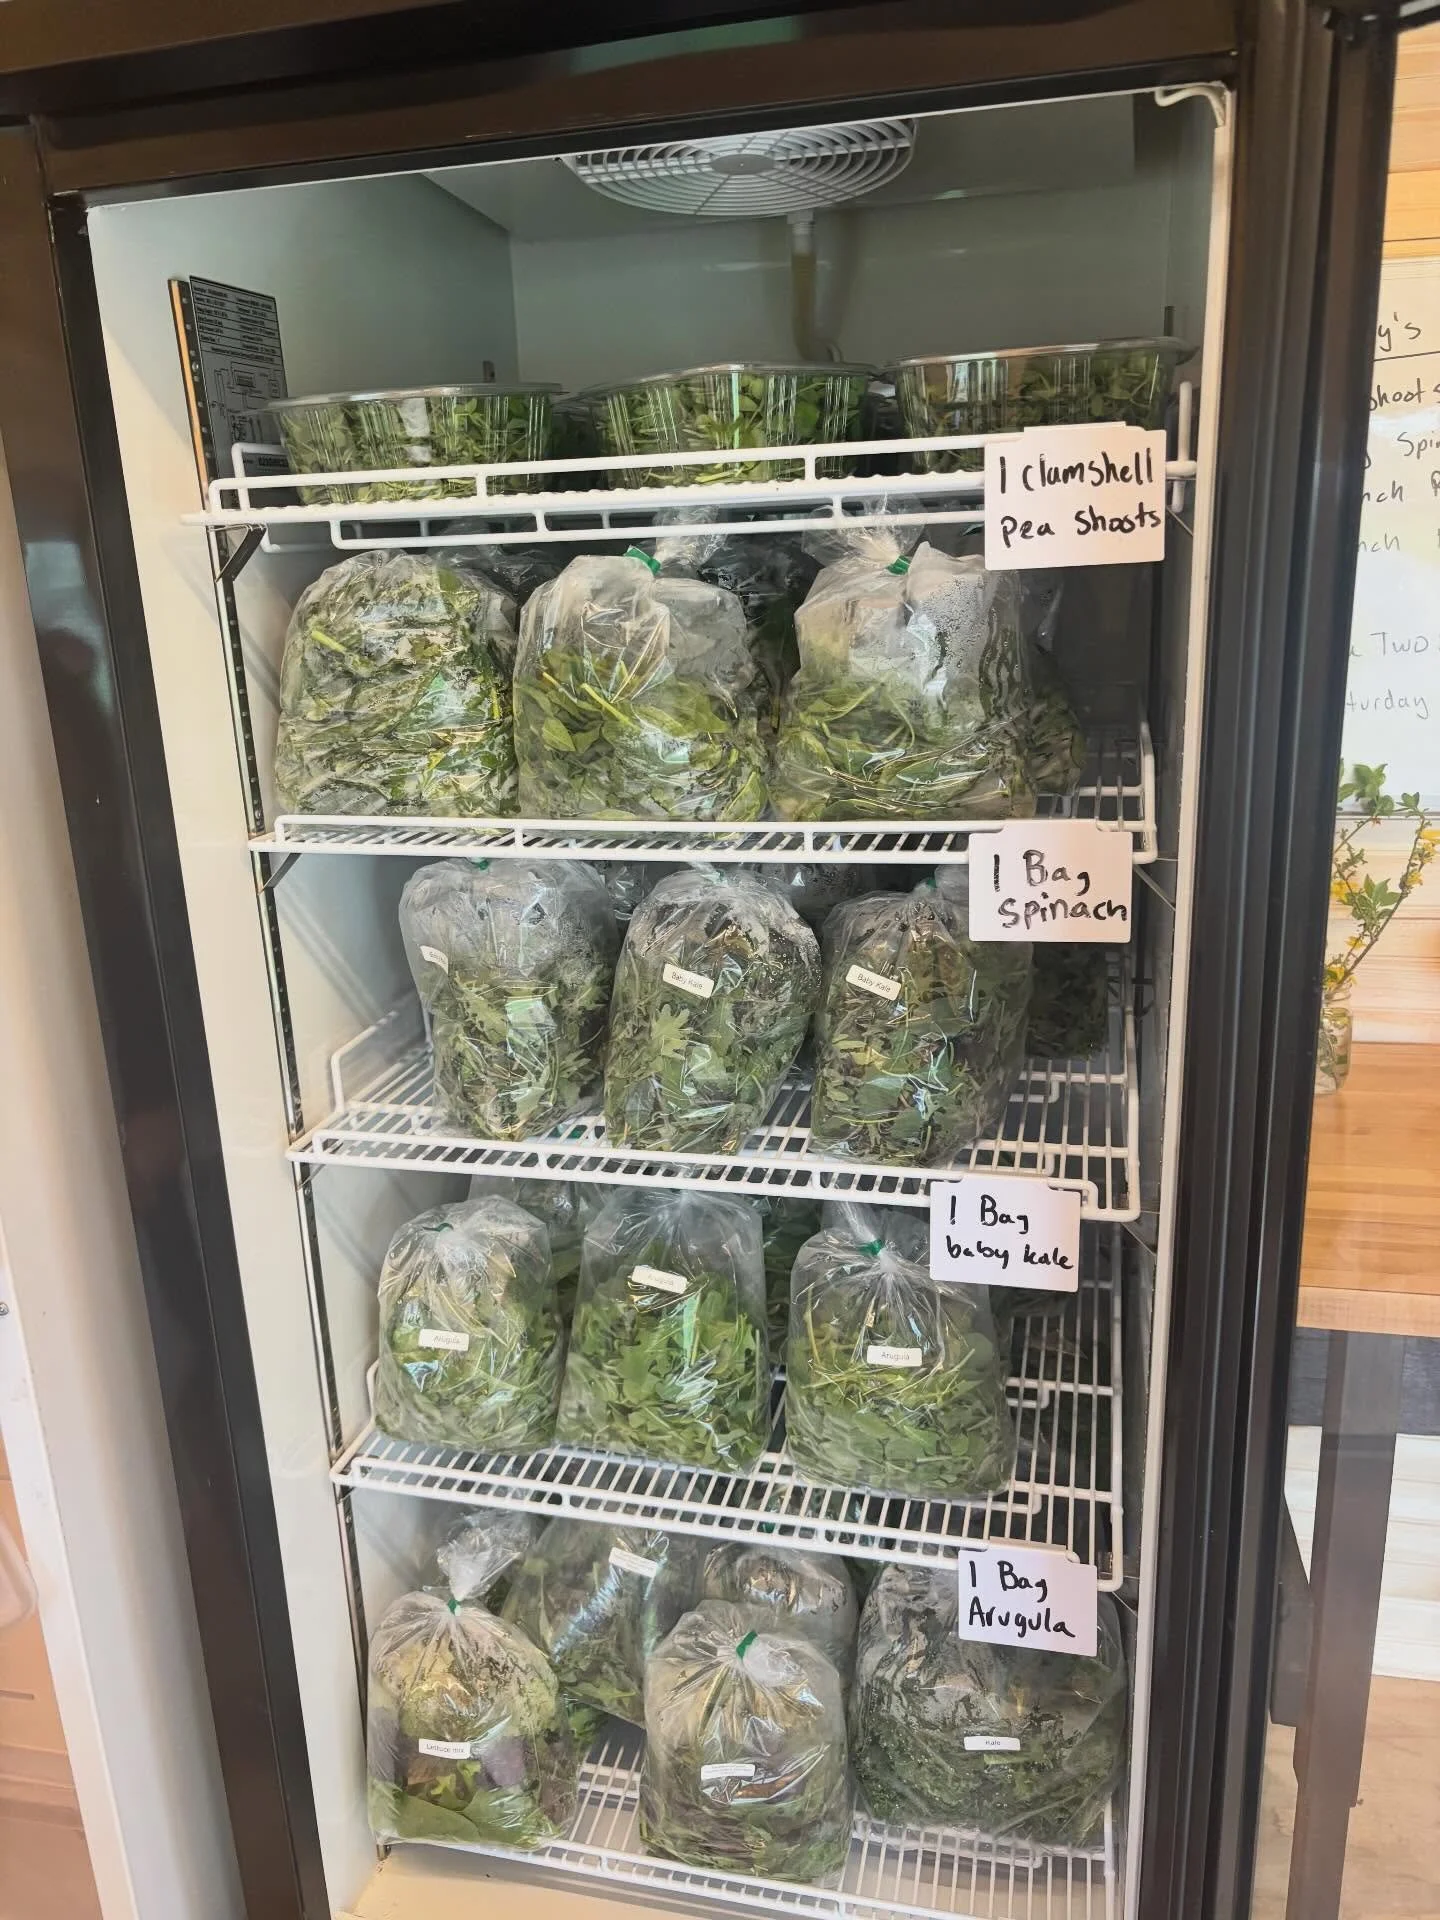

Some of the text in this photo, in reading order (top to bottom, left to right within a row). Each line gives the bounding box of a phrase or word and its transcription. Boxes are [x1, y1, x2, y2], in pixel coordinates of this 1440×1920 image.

[1000, 456, 1006, 494] 1
[1000, 515, 1055, 549] pea
[993, 849, 1090, 897] 1 Bag
[671, 971, 687, 985] Baby
[857, 973, 873, 987] Baby
[950, 1194, 1029, 1235] 1 Bag
[946, 1235, 1074, 1270] baby kale
[433, 1335, 460, 1345] Arugula
[880, 1351, 910, 1361] Arugula
[969, 1560, 1048, 1603] 1 Bag
[969, 1596, 1076, 1638] Arugula
